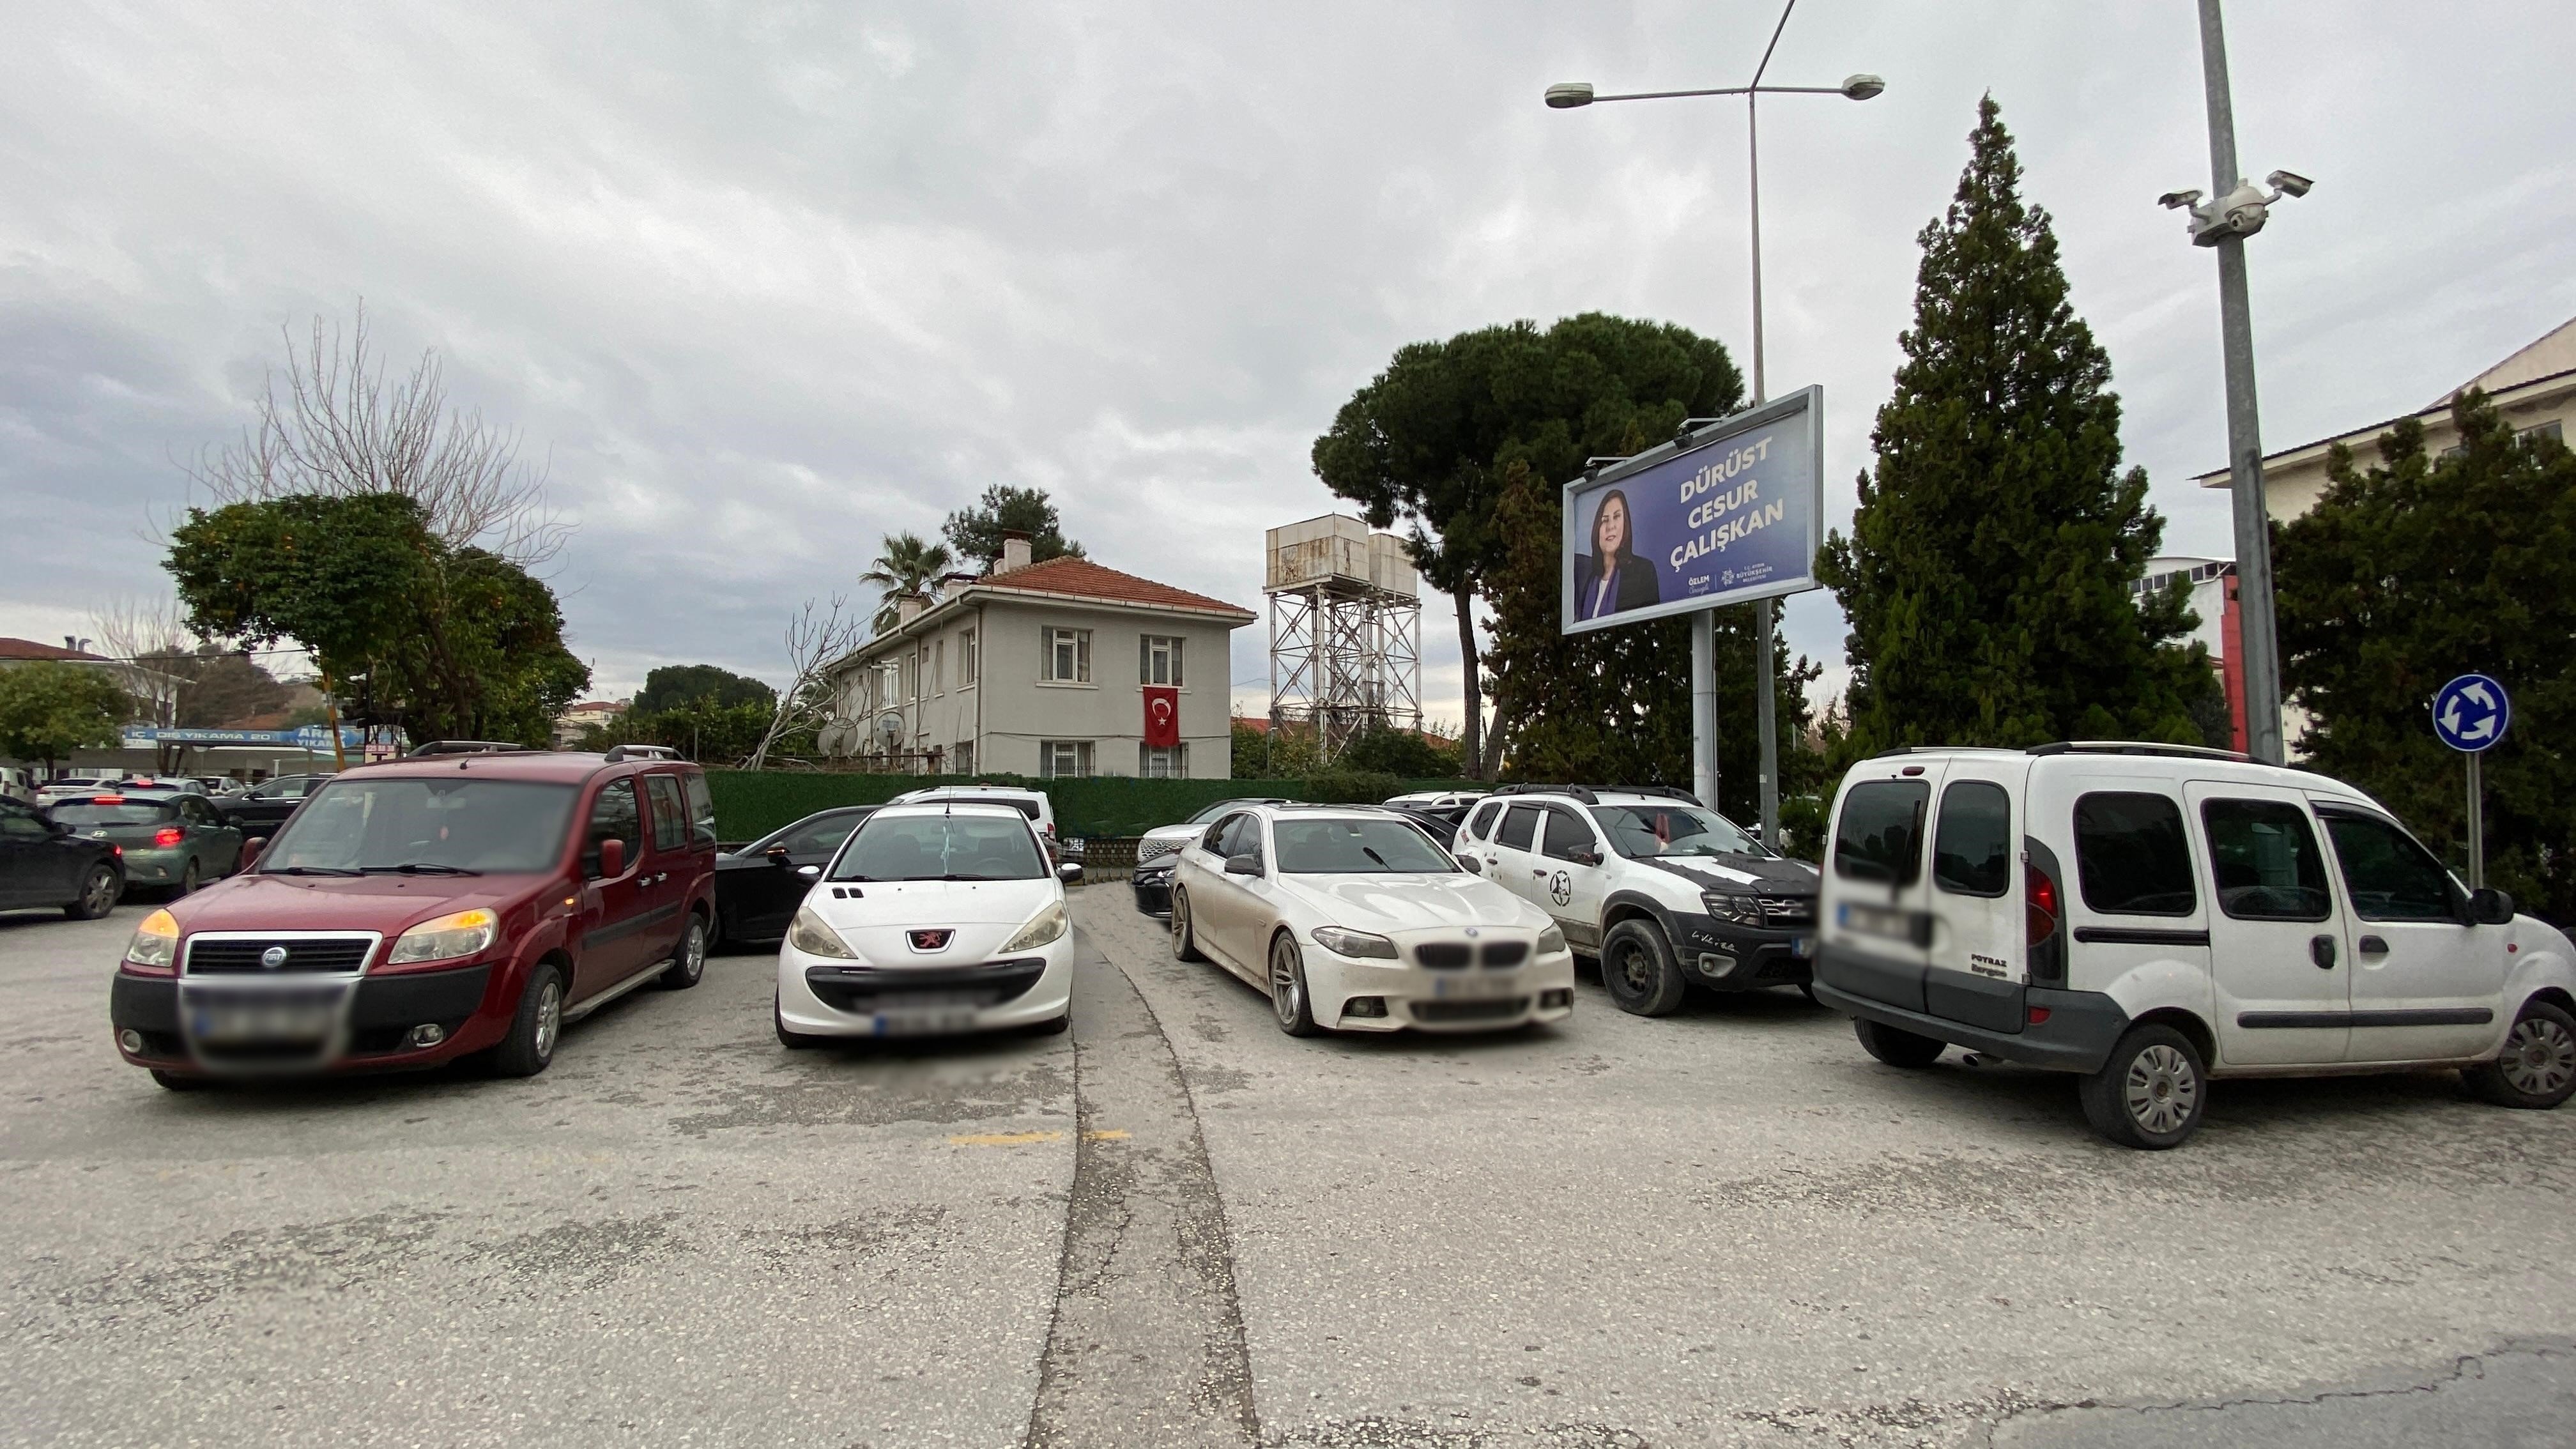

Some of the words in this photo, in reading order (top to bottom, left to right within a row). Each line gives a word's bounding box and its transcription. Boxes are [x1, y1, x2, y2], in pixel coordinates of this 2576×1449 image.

[1680, 436, 1772, 503] DÜRÜST
[1688, 479, 1758, 529] CESUR
[1670, 498, 1783, 572] ÇALIŞKAN
[1688, 574, 1710, 586] ÖZLEM
[1972, 954, 2007, 967] POYRAZ
